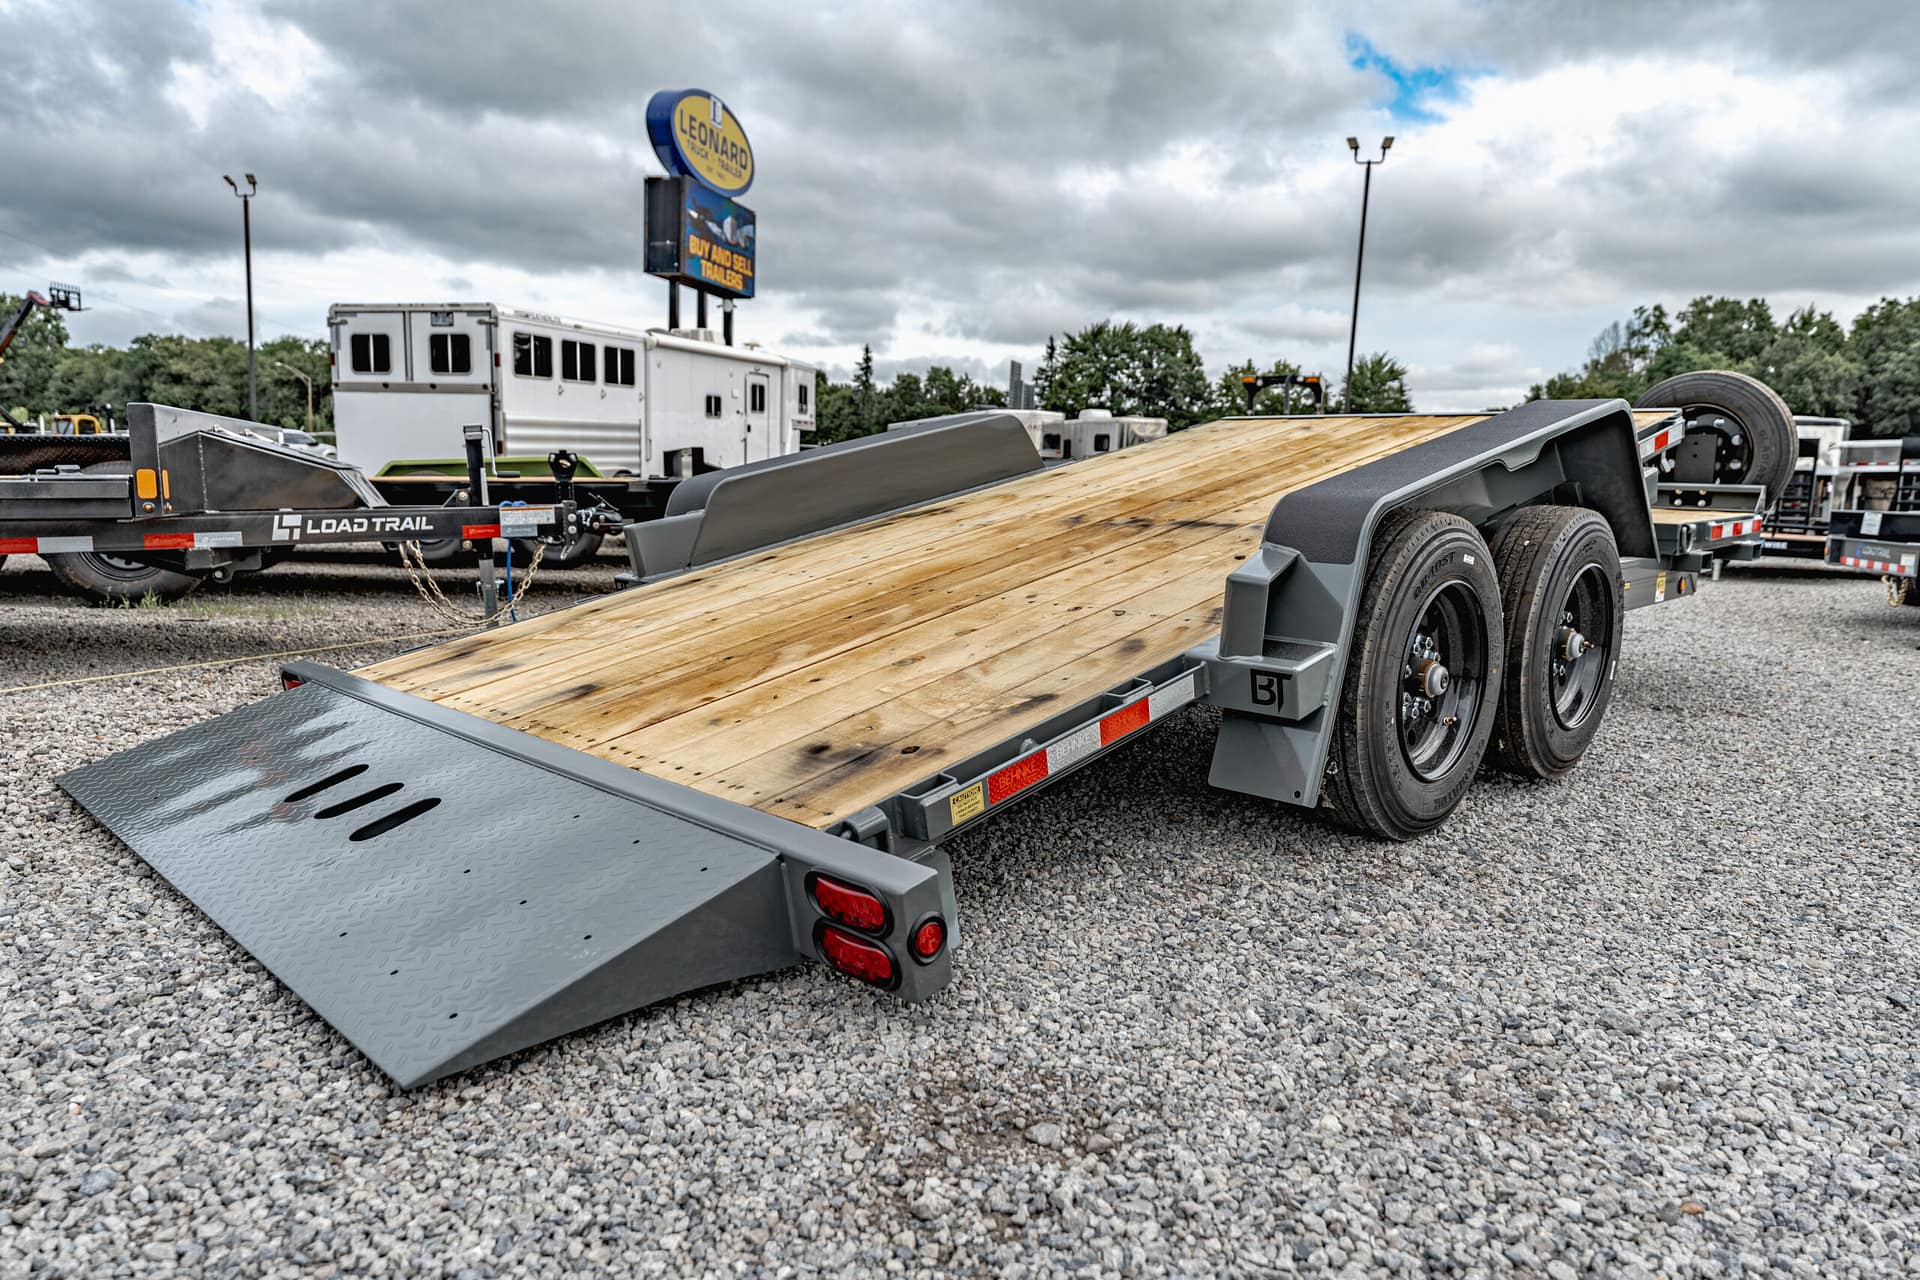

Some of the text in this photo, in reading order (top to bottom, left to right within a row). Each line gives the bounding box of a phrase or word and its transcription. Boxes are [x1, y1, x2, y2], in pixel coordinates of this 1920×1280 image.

[680, 108, 748, 170] LEONARD
[689, 234, 753, 277] BUY AND SELL
[700, 259, 744, 291] TRAILERS
[306, 518, 368, 534] LOAD
[372, 516, 434, 532] TRAIL
[1109, 709, 1141, 731] BEHNKE
[1057, 734, 1091, 759] BEHNKE
[998, 760, 1037, 789] BEHNKE
